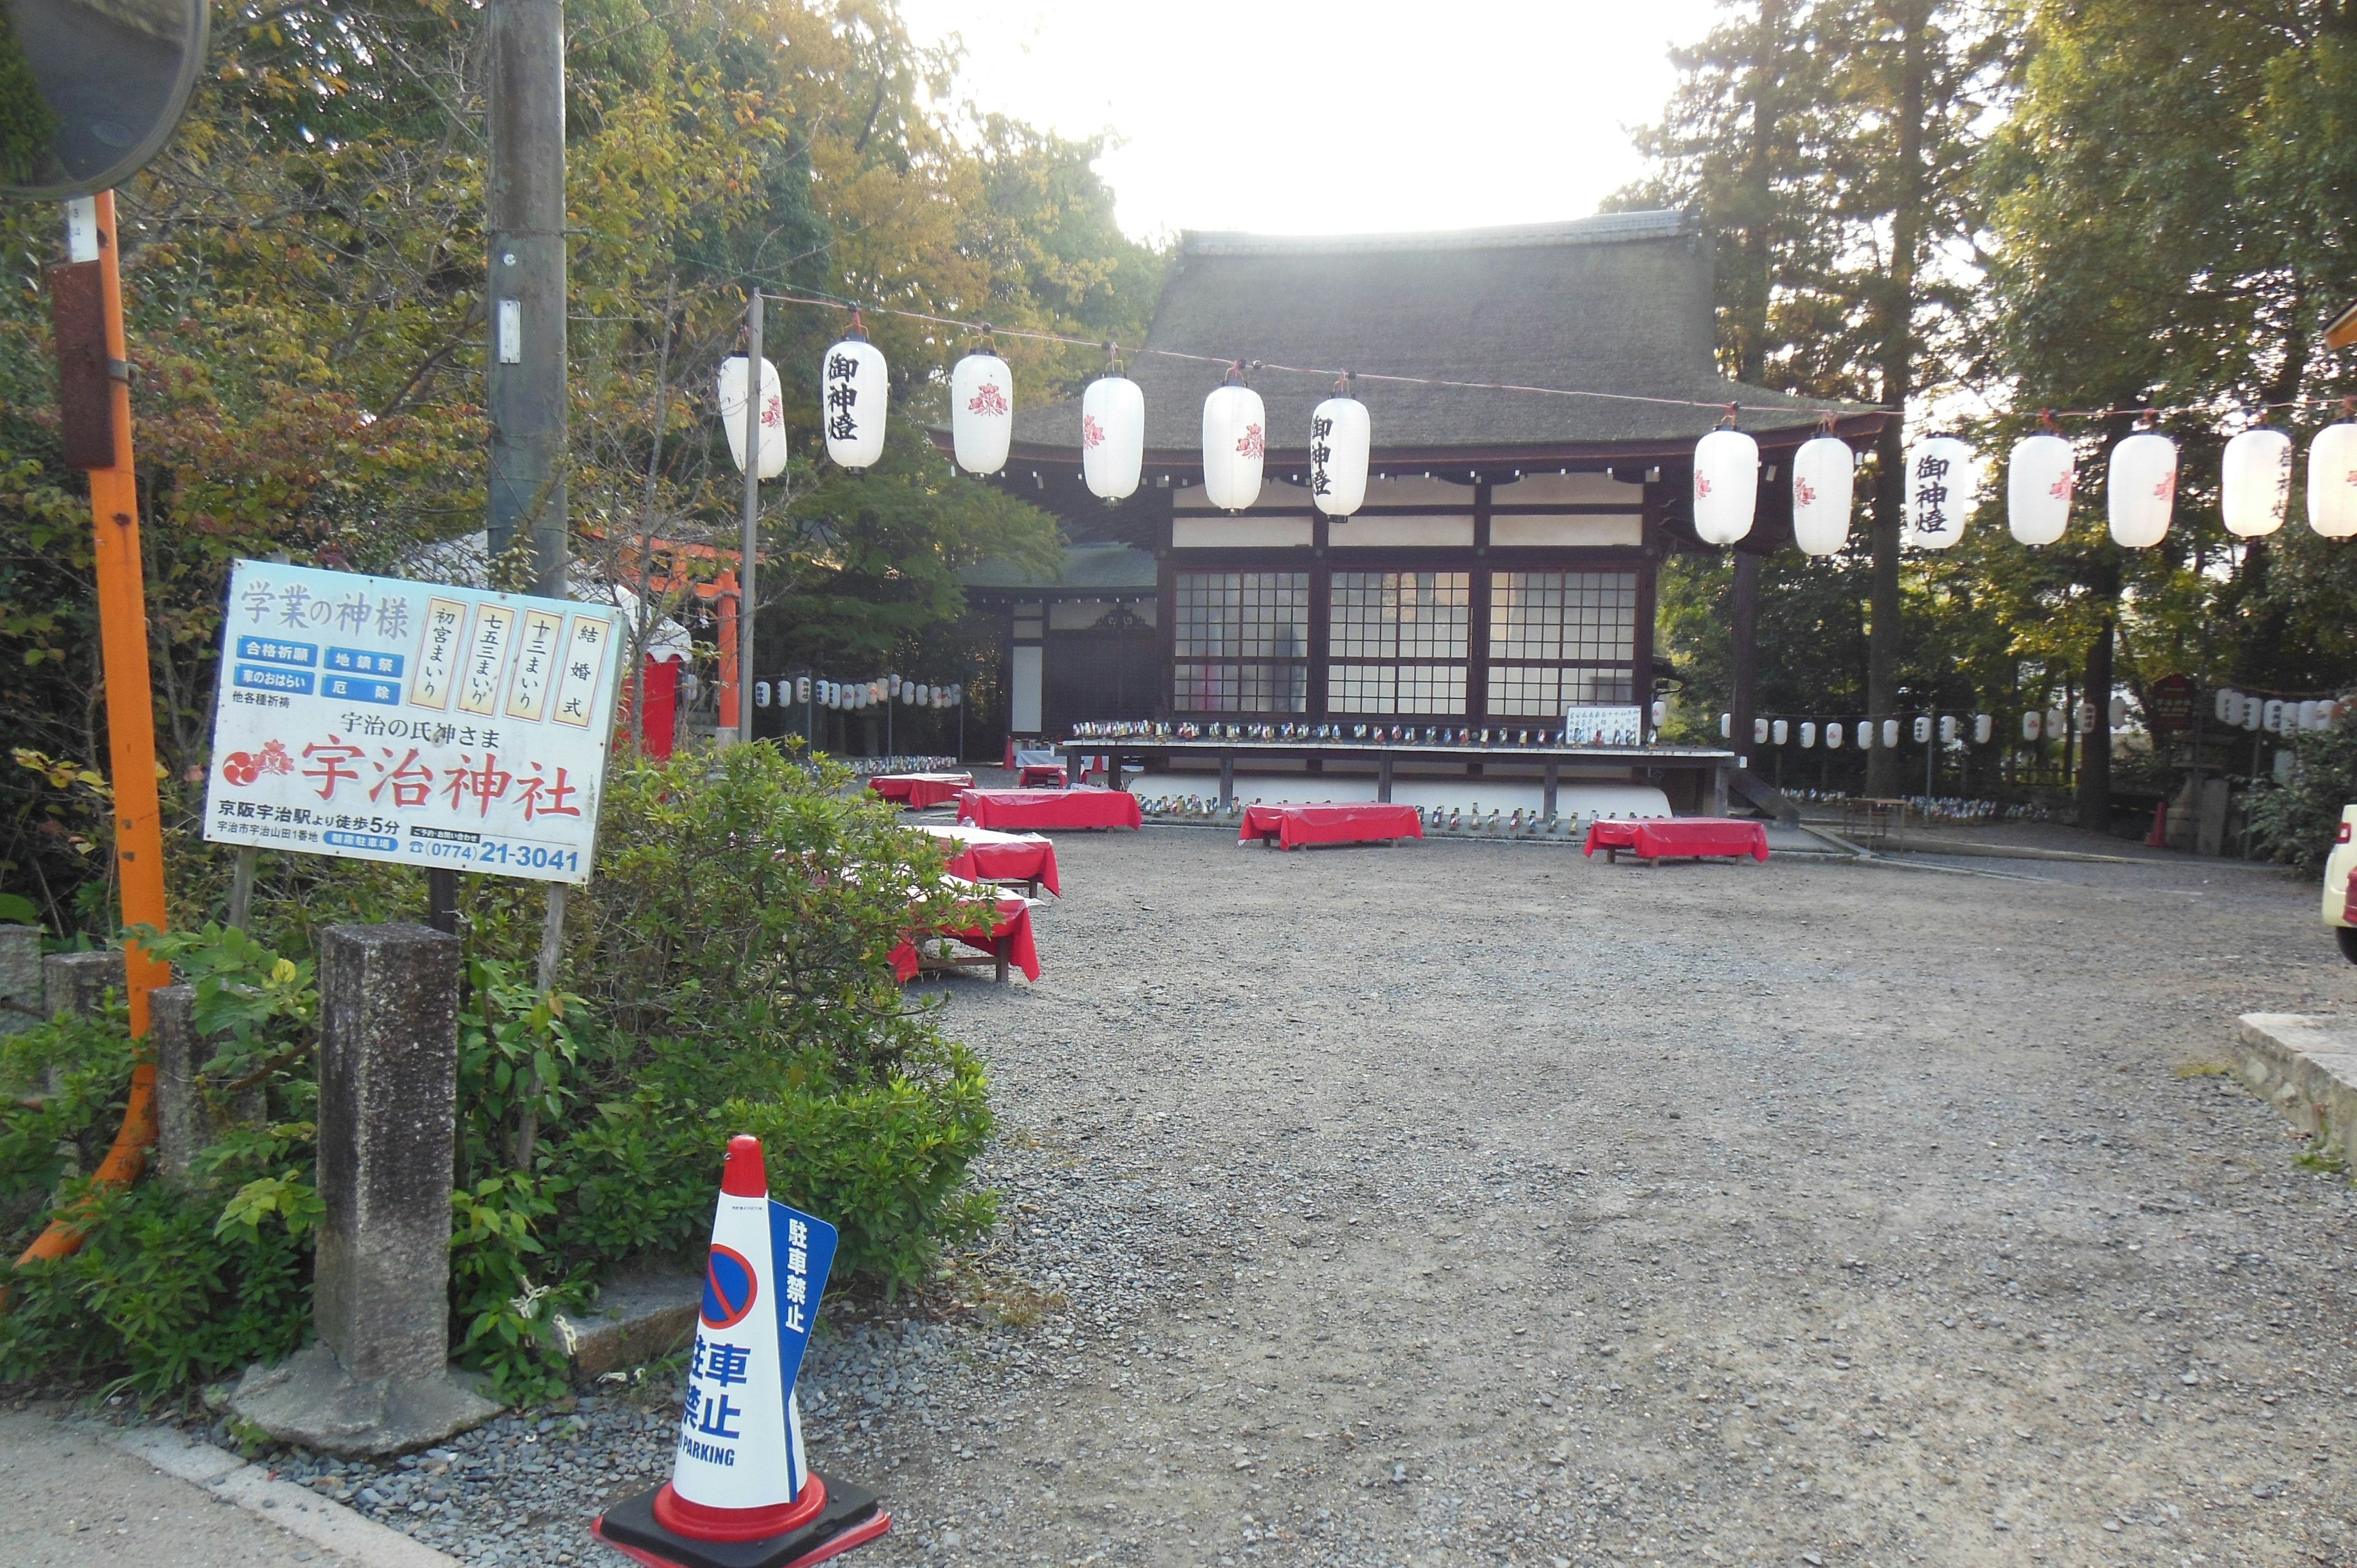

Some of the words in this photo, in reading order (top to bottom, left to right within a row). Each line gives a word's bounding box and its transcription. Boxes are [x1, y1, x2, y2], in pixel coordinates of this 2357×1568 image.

[827, 352, 858, 441] 御神燈
[1915, 454, 1949, 534] 御神燈
[241, 581, 408, 640] 学業の神様
[242, 669, 306, 689] 車のおはらい
[247, 641, 309, 662] 合格祈願
[335, 653, 393, 673] 地鎮祭
[425, 608, 455, 698] 初宮まいり
[473, 614, 503, 705] 七五三まいり
[521, 620, 550, 709] 十三まいり
[563, 625, 599, 717] 結婚式
[341, 712, 500, 749] 宇治の氏神さま
[301, 734, 581, 822] 宇治神社
[217, 821, 319, 843] 宇治市宇治山田1番地
[218, 800, 400, 835] 京阪宇治駅より徒歩5分
[786, 1218, 808, 1334] 駐車禁止
[683, 1435, 735, 1467] PARKING
